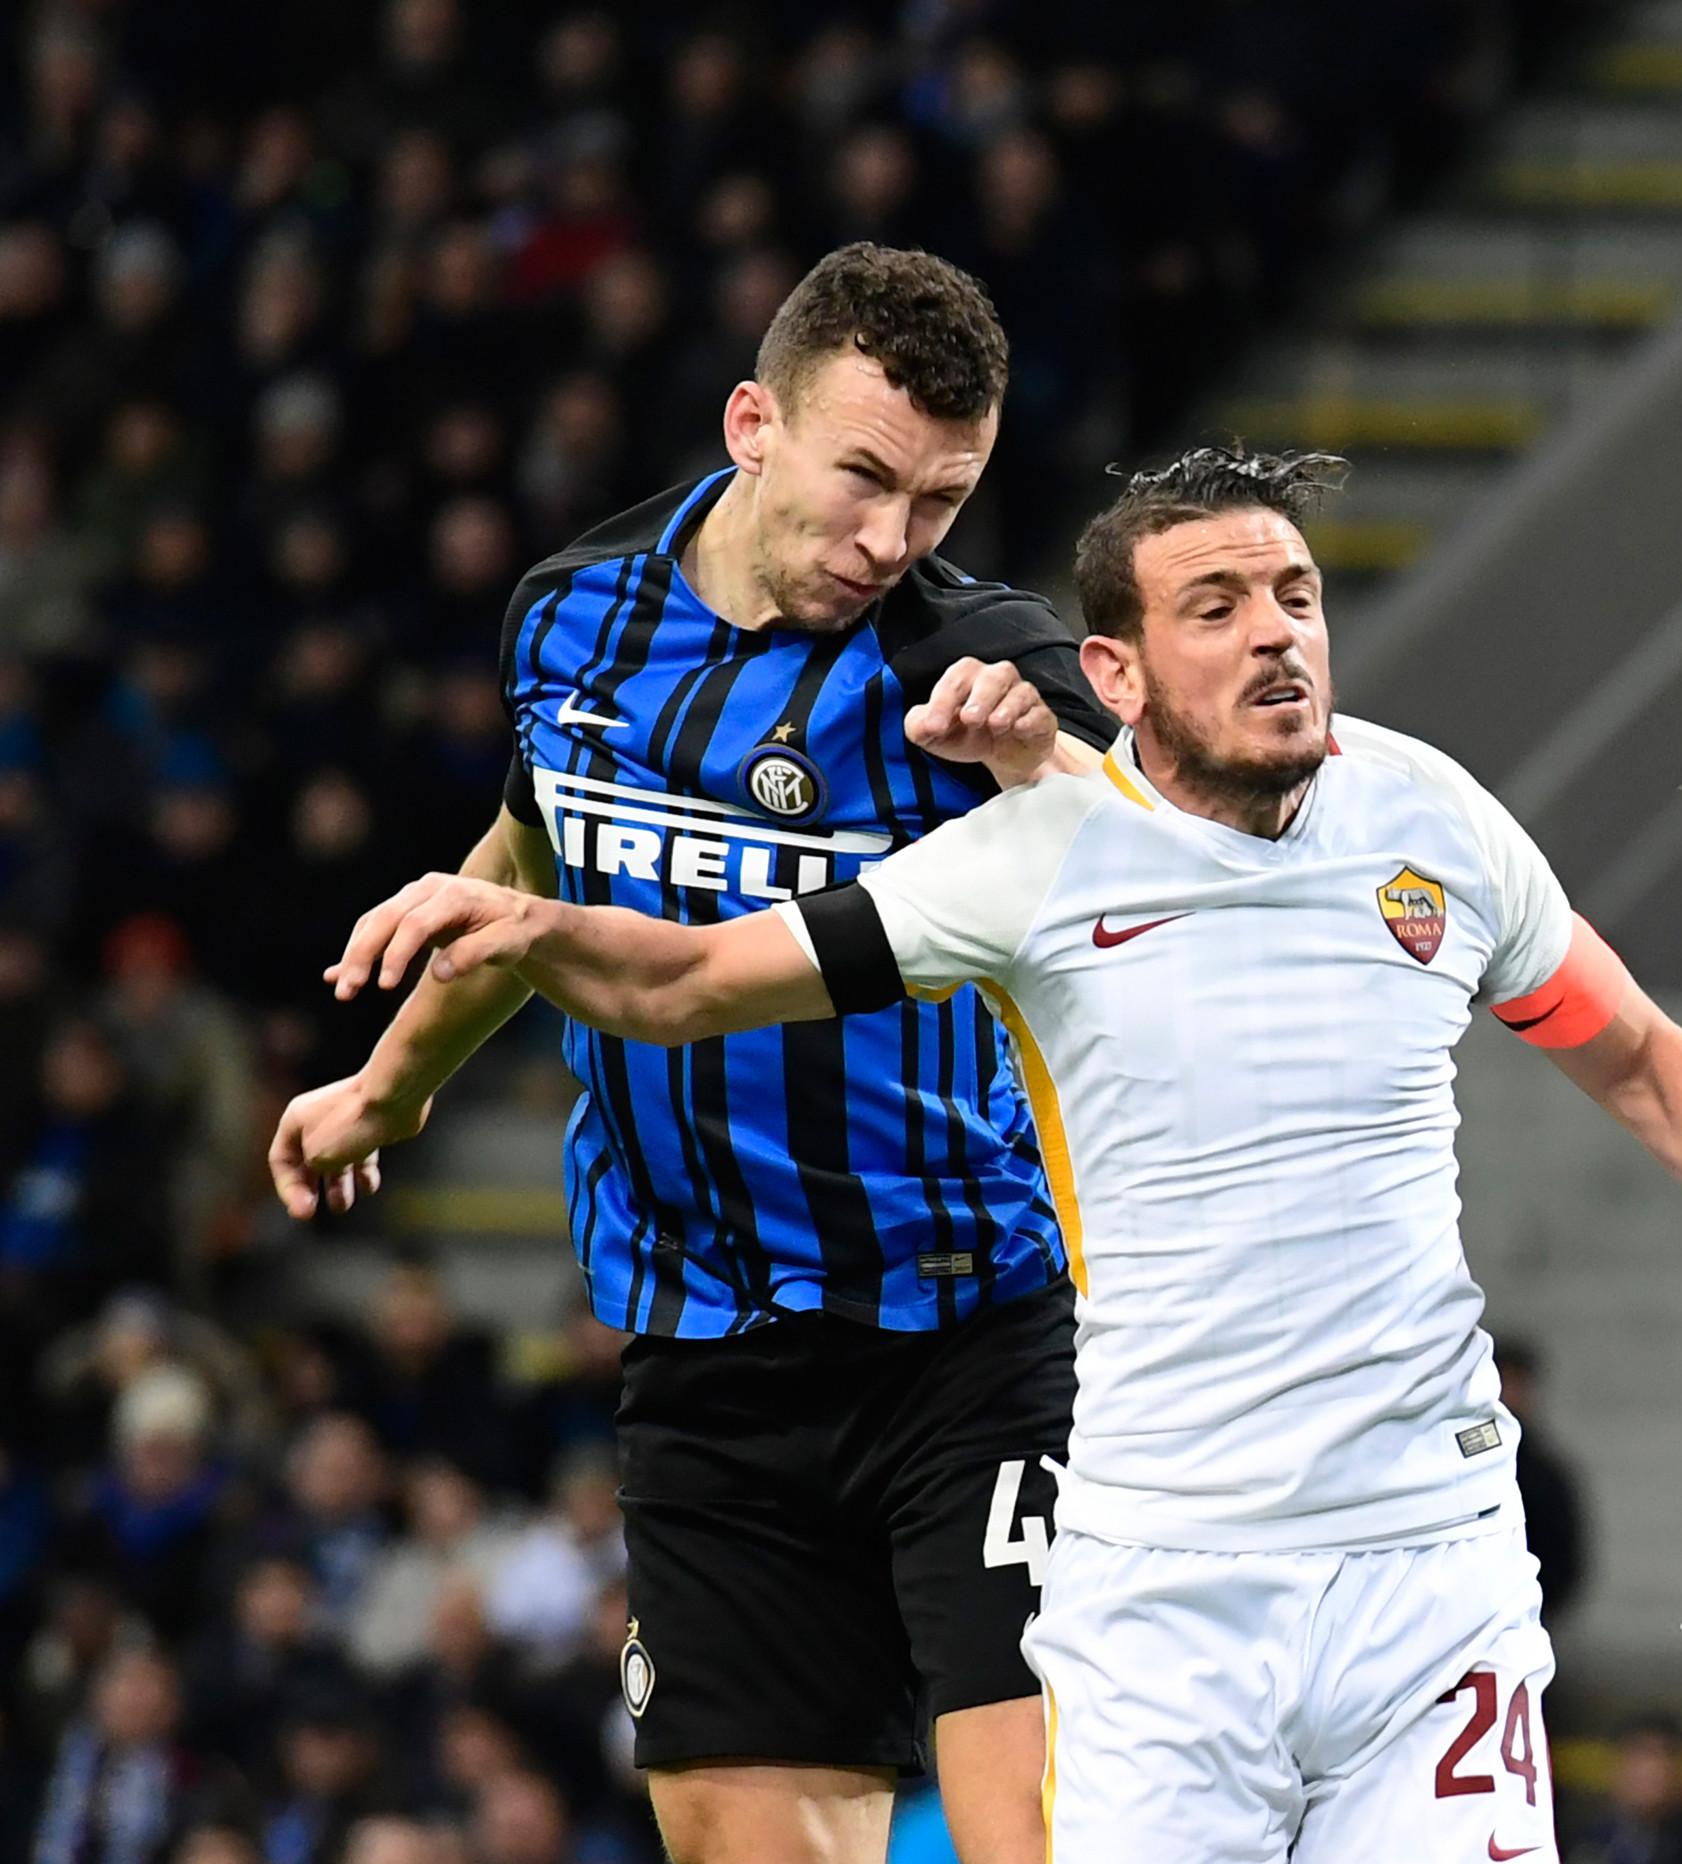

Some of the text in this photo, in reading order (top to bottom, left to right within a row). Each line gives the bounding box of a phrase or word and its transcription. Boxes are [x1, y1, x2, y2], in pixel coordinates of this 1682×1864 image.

[533, 764, 894, 901] PIRELL
[1396, 922, 1442, 938] ROMA
[1435, 1671, 1538, 1808] 24
